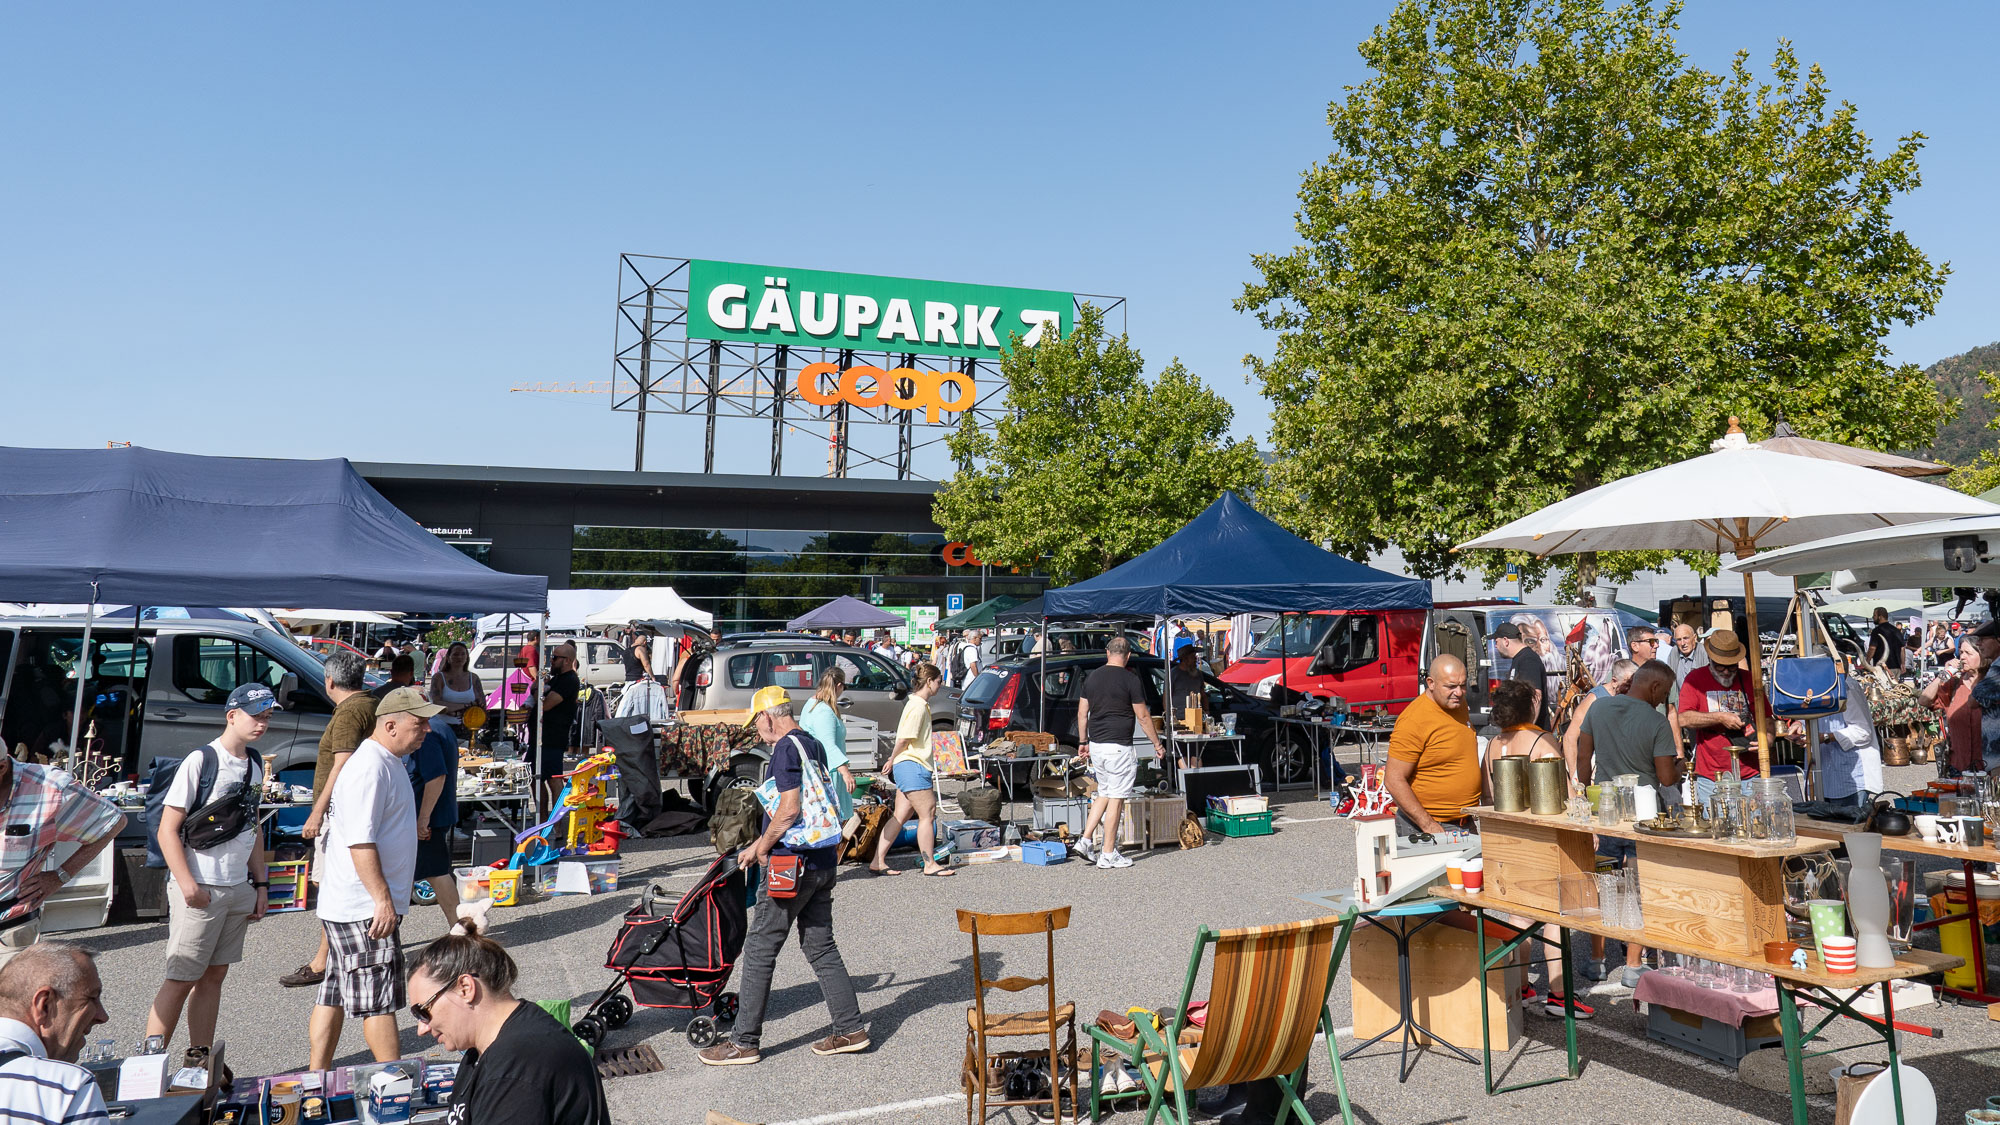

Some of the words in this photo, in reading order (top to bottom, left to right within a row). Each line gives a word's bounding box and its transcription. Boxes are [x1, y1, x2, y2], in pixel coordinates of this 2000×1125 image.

[707, 276, 1001, 348] GÄUPARK
[797, 362, 977, 424] coop
[951, 597, 960, 608] P
